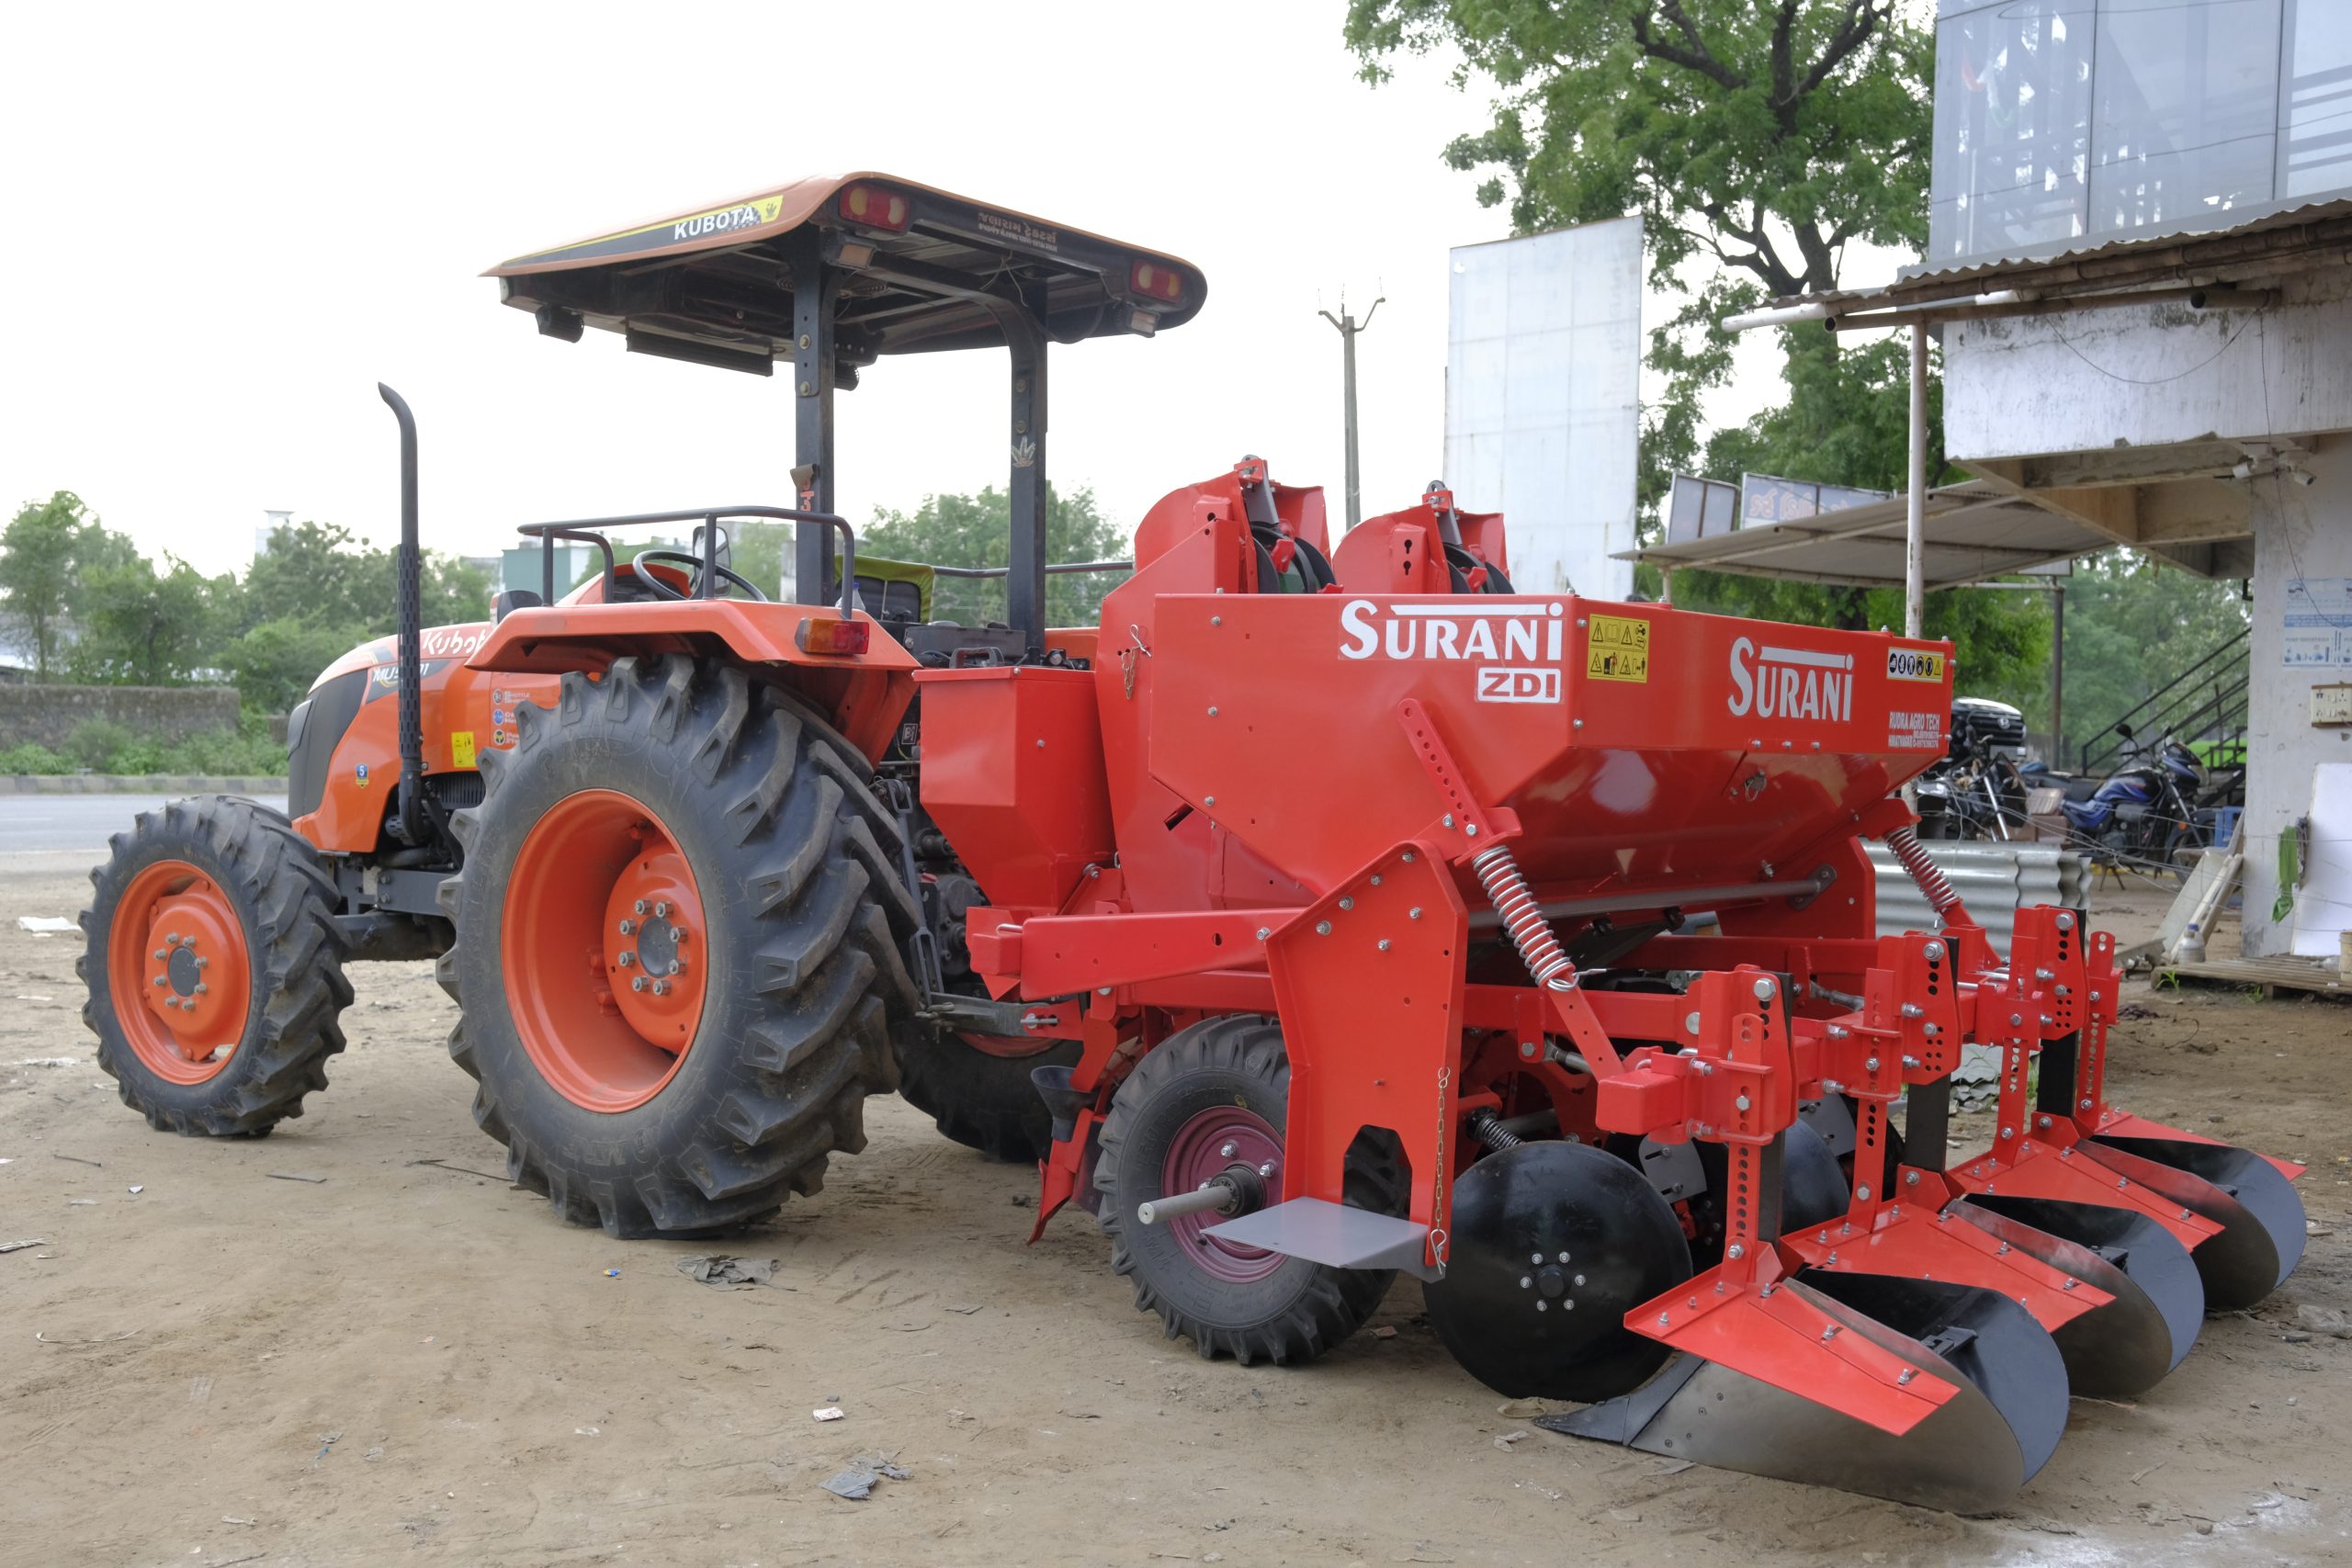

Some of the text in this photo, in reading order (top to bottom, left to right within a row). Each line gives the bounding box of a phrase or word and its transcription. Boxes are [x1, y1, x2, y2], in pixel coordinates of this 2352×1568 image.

[674, 206, 754, 241] KUBOTA
[423, 629, 487, 655] Kubot
[1482, 672, 1557, 698] ZDI
[1889, 711, 1940, 732] RUDRA AGRO TECH
[359, 764, 366, 777] 5
